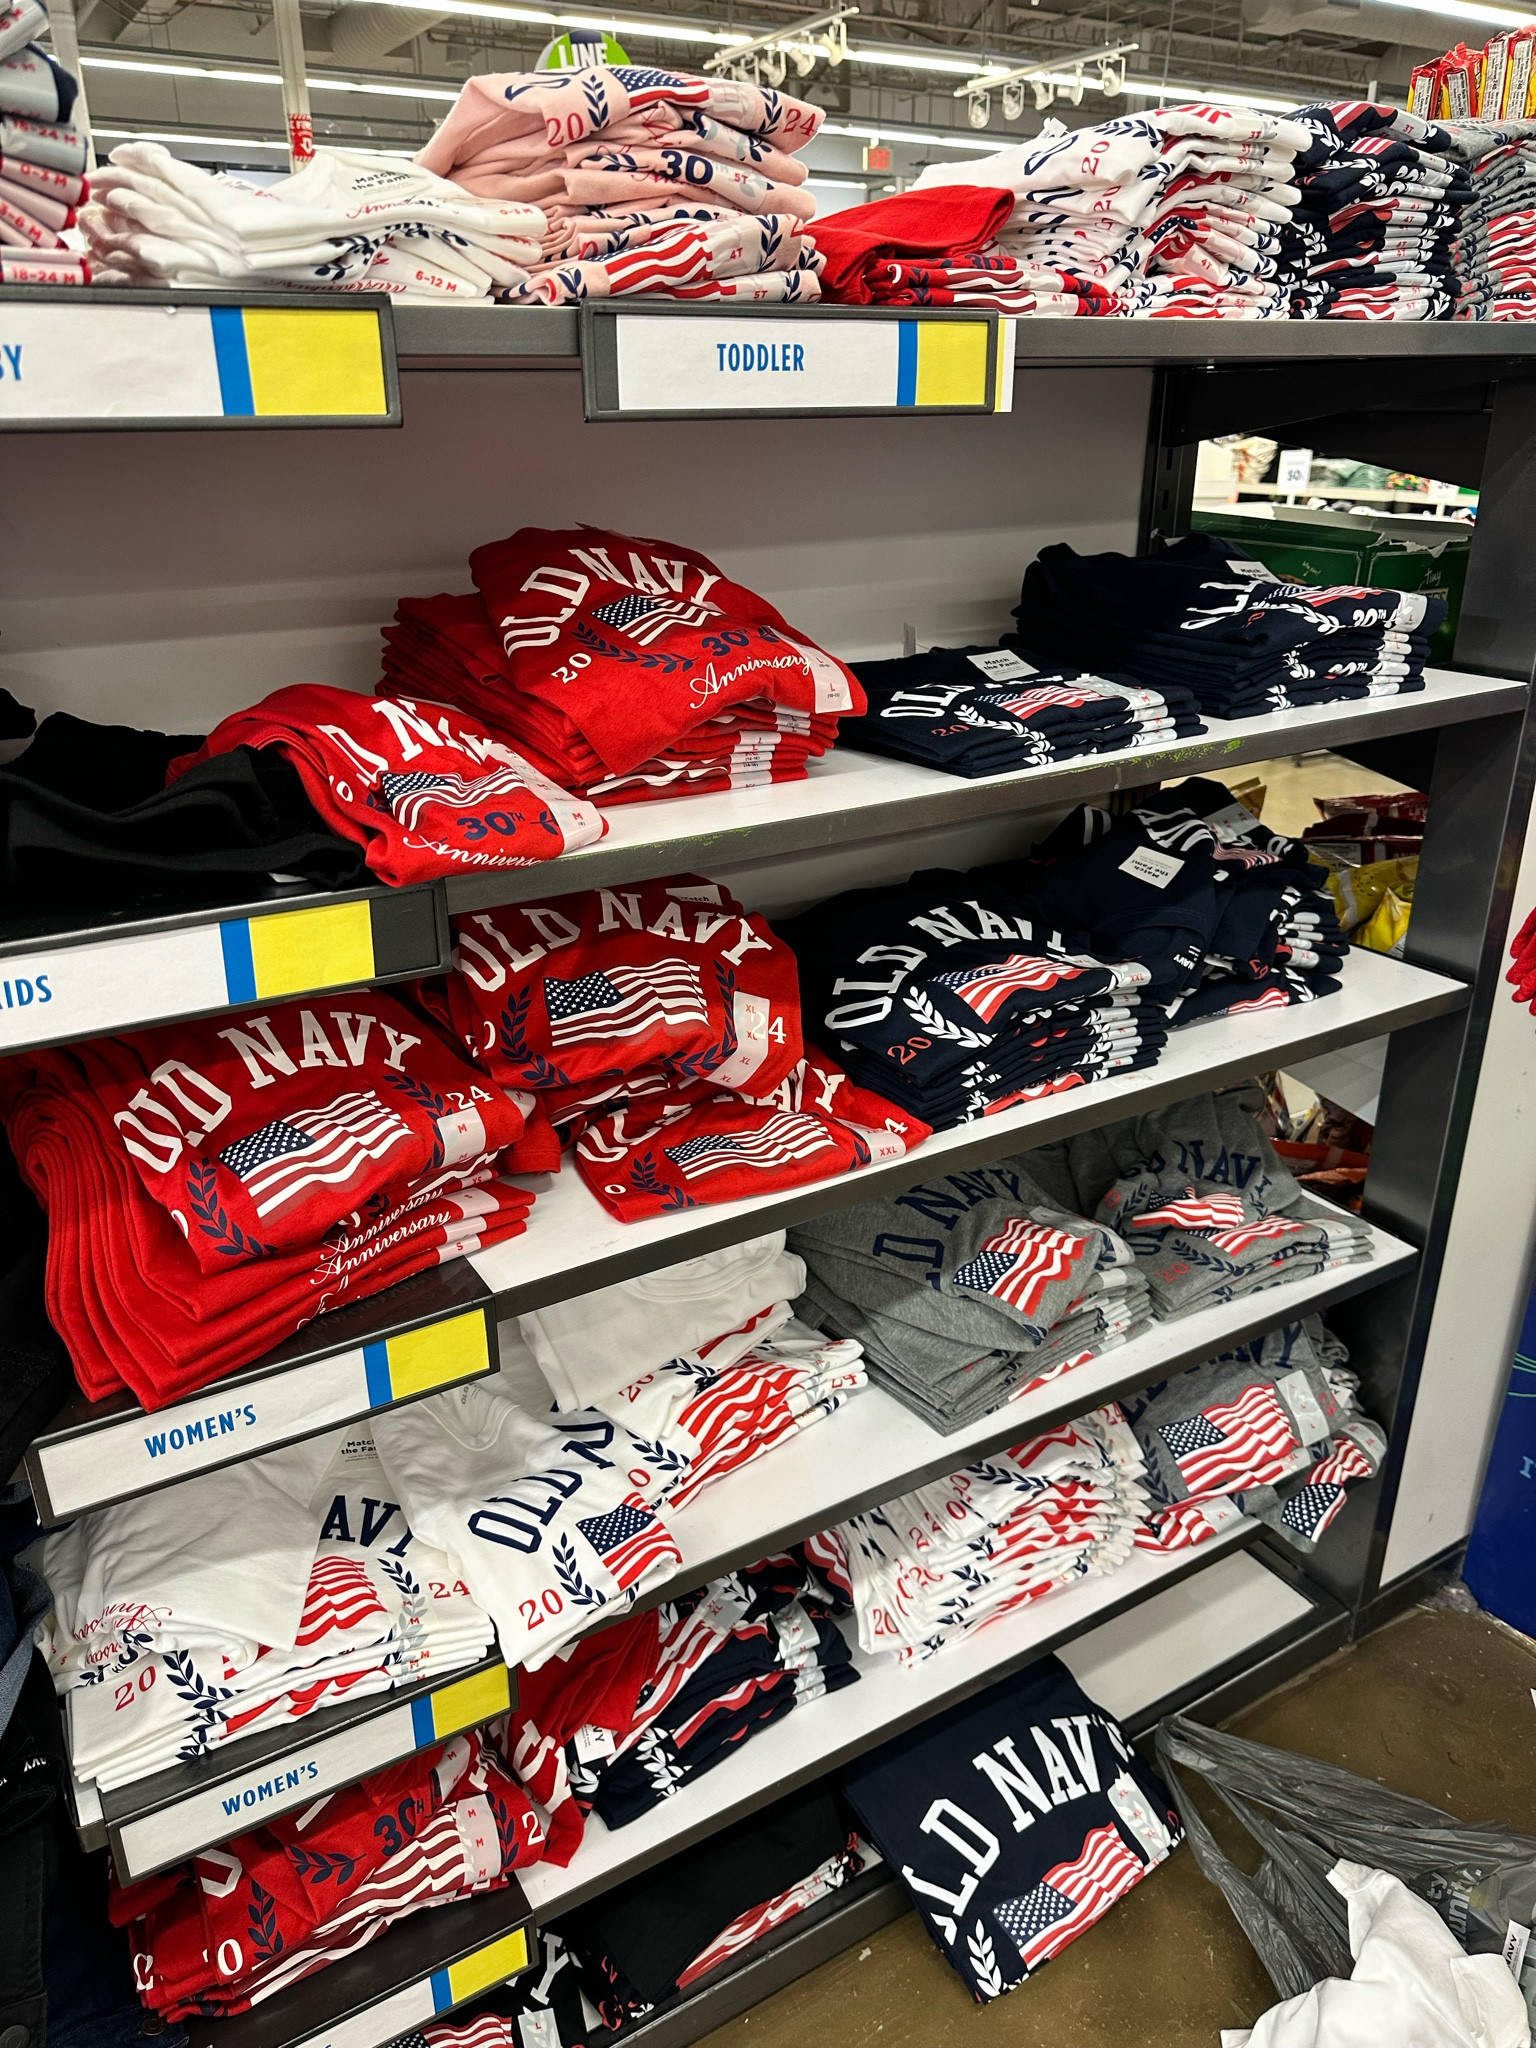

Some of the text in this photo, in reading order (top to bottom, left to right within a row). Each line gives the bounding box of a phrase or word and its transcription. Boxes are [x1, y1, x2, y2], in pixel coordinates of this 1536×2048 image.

[783, 108, 817, 136] 24
[546, 112, 584, 147] 20
[1250, 131, 1262, 139] 3T
[1402, 124, 1414, 134] 3T
[1081, 141, 1110, 176] 20
[54, 174, 68, 187] M
[355, 171, 395, 184] Match
[734, 173, 749, 185] 5T
[352, 182, 374, 191] the
[1238, 195, 1249, 205] 3T
[1403, 216, 1414, 224] 4T
[28, 225, 43, 241] M
[730, 248, 743, 260] 4T
[1201, 259, 1212, 271] 4T
[12, 267, 77, 285] 18-24 M
[415, 270, 457, 292] 6-12 M
[753, 290, 767, 299] 5T
[1052, 294, 1063, 302] 4T
[716, 343, 805, 373] TODDLER
[1424, 567, 1442, 587] tiny
[500, 547, 723, 658] OLD NAVY
[984, 658, 1010, 666] Match
[551, 652, 592, 685] 20
[829, 683, 836, 692] L
[931, 723, 971, 738] 20
[572, 812, 583, 820] M
[456, 810, 526, 841] 30TH
[1131, 859, 1153, 871] Fam!
[1134, 864, 1160, 879] Match
[1154, 868, 1169, 877] the
[453, 889, 772, 992] OLD NAVY
[1173, 953, 1195, 970] NAVY
[0, 974, 53, 1010] IDS
[824, 945, 928, 1030] OLD
[745, 1004, 757, 1014] XL
[748, 1012, 787, 1044] 24
[746, 1030, 758, 1041] XL
[217, 1010, 422, 1090] NAVY
[887, 1036, 932, 1065] 20
[739, 1056, 751, 1065] XL
[719, 1075, 732, 1083] XL
[446, 1085, 494, 1110] 24
[514, 1091, 524, 1100] M
[457, 1124, 468, 1134] M
[879, 1146, 898, 1157] XXL
[320, 1188, 444, 1260] Anniversary
[309, 1209, 452, 1286] Anniversary
[456, 1242, 464, 1251] S
[1100, 1402, 1127, 1426] 24
[145, 1404, 257, 1459] WOMEN'S
[467, 1468, 584, 1554] OLD
[1217, 1510, 1229, 1520] XL
[428, 1579, 471, 1600] 24
[518, 1588, 564, 1632] 20
[711, 1605, 723, 1616] XL
[410, 1618, 420, 1626] M
[420, 1651, 430, 1660] M
[410, 1660, 420, 1669] M
[115, 1665, 157, 1712] 20
[221, 1760, 319, 1817] WOMEN'S
[1117, 1788, 1129, 1799] XL
[467, 1809, 477, 1818] M
[1132, 1808, 1143, 1819] XL
[1146, 1829, 1157, 1839] XL
[476, 1837, 485, 1847] M
[478, 1867, 488, 1877] M
[536, 2022, 542, 2030] L
